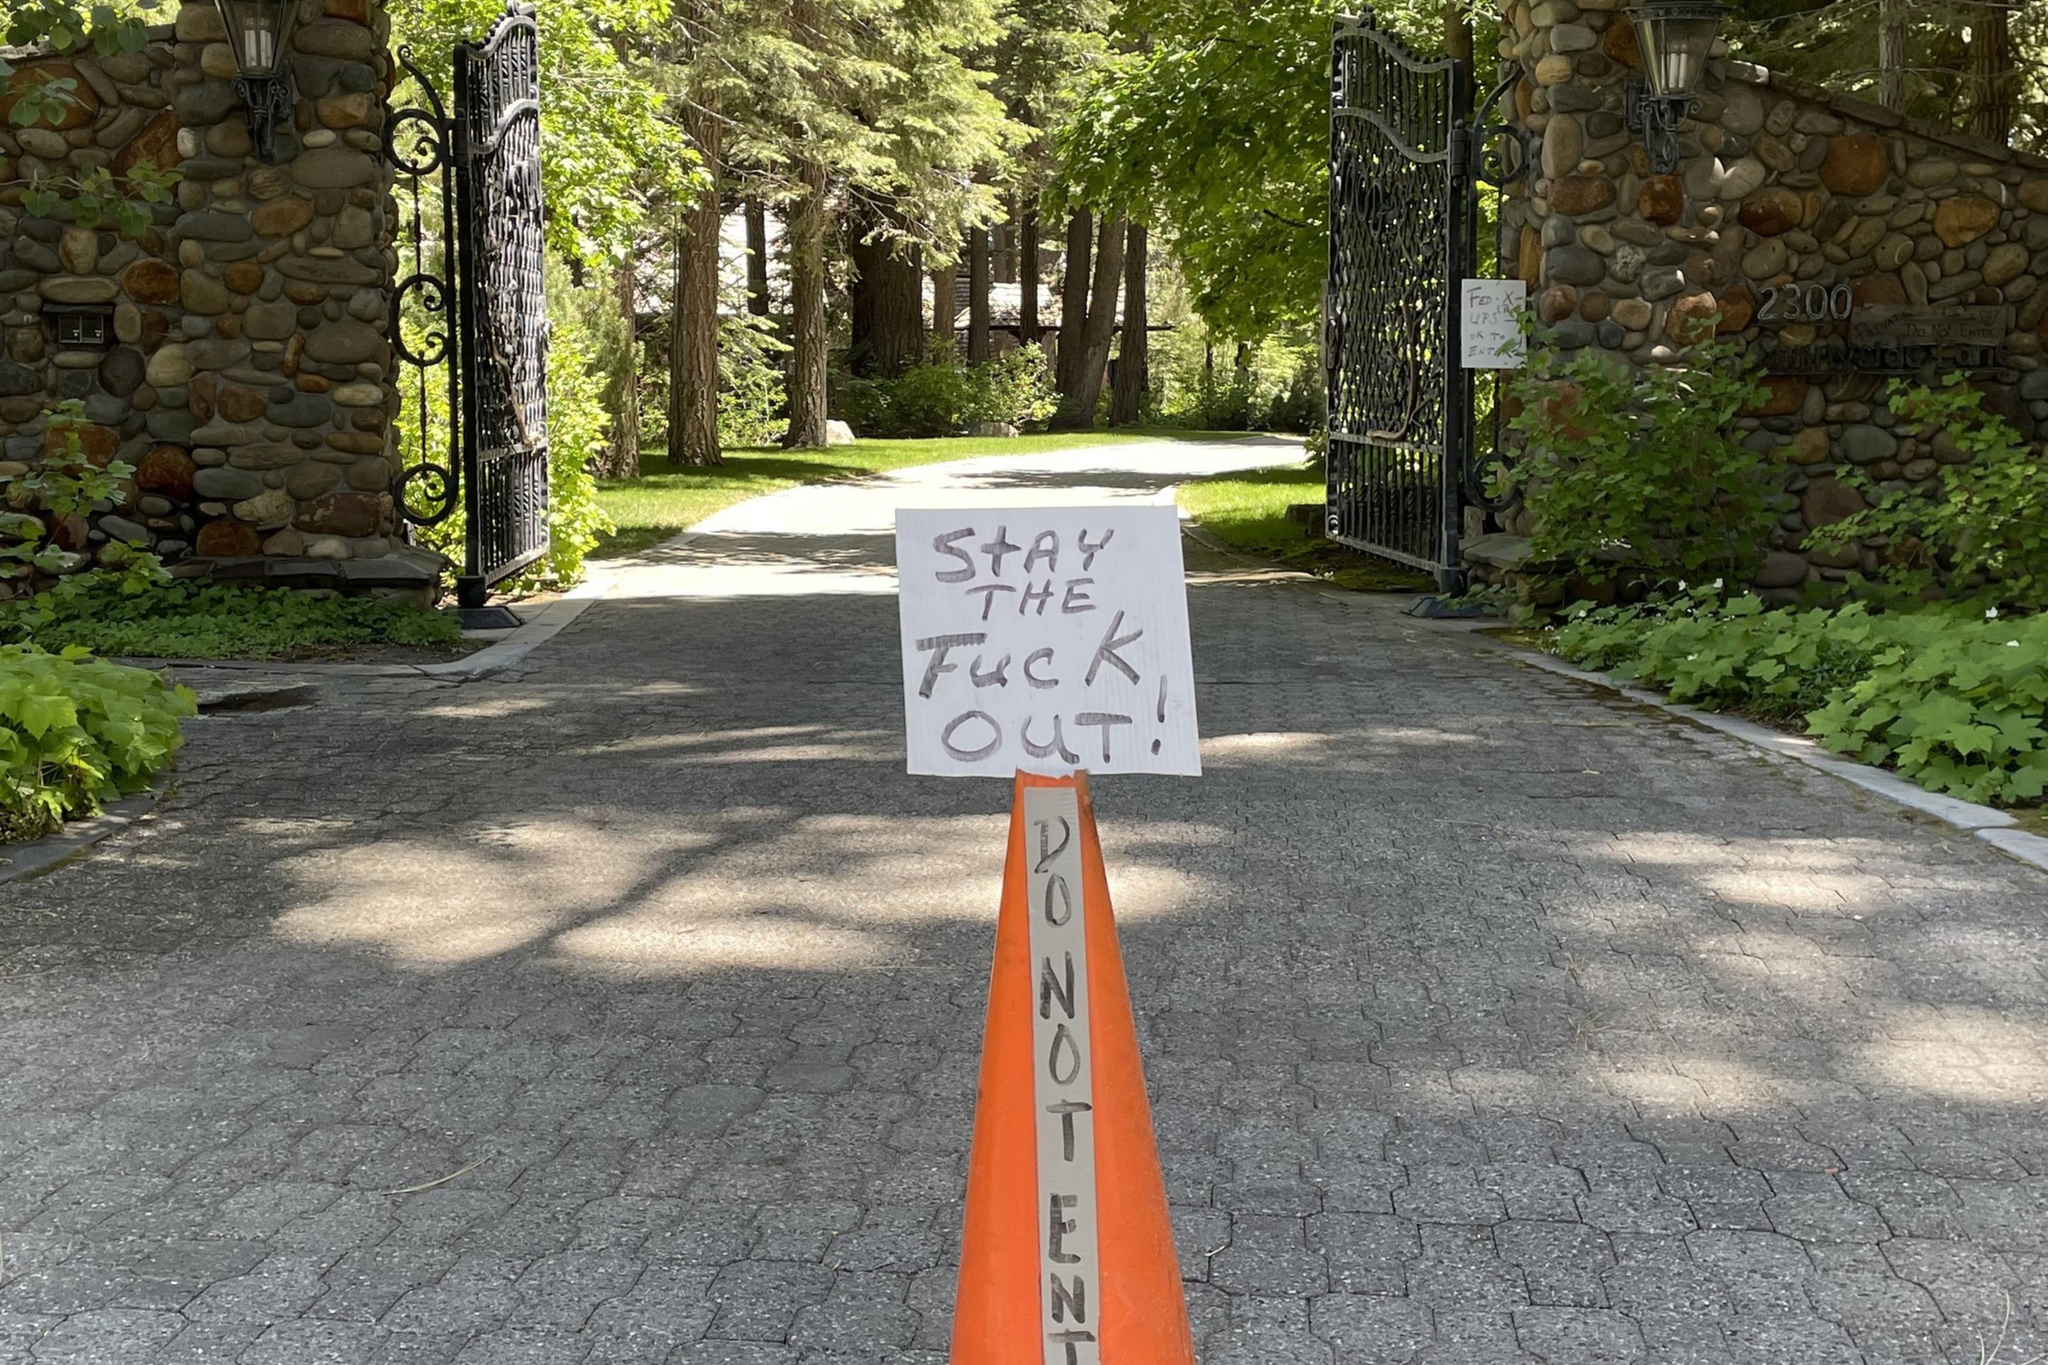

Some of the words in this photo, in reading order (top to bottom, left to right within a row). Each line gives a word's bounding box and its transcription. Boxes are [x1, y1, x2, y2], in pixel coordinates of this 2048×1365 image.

[1469, 312, 1498, 325] UPS
[1757, 283, 1853, 321] 2300
[965, 578, 1097, 621] THE
[1033, 815, 1072, 929] DO
[1039, 950, 1093, 1162] NOT
